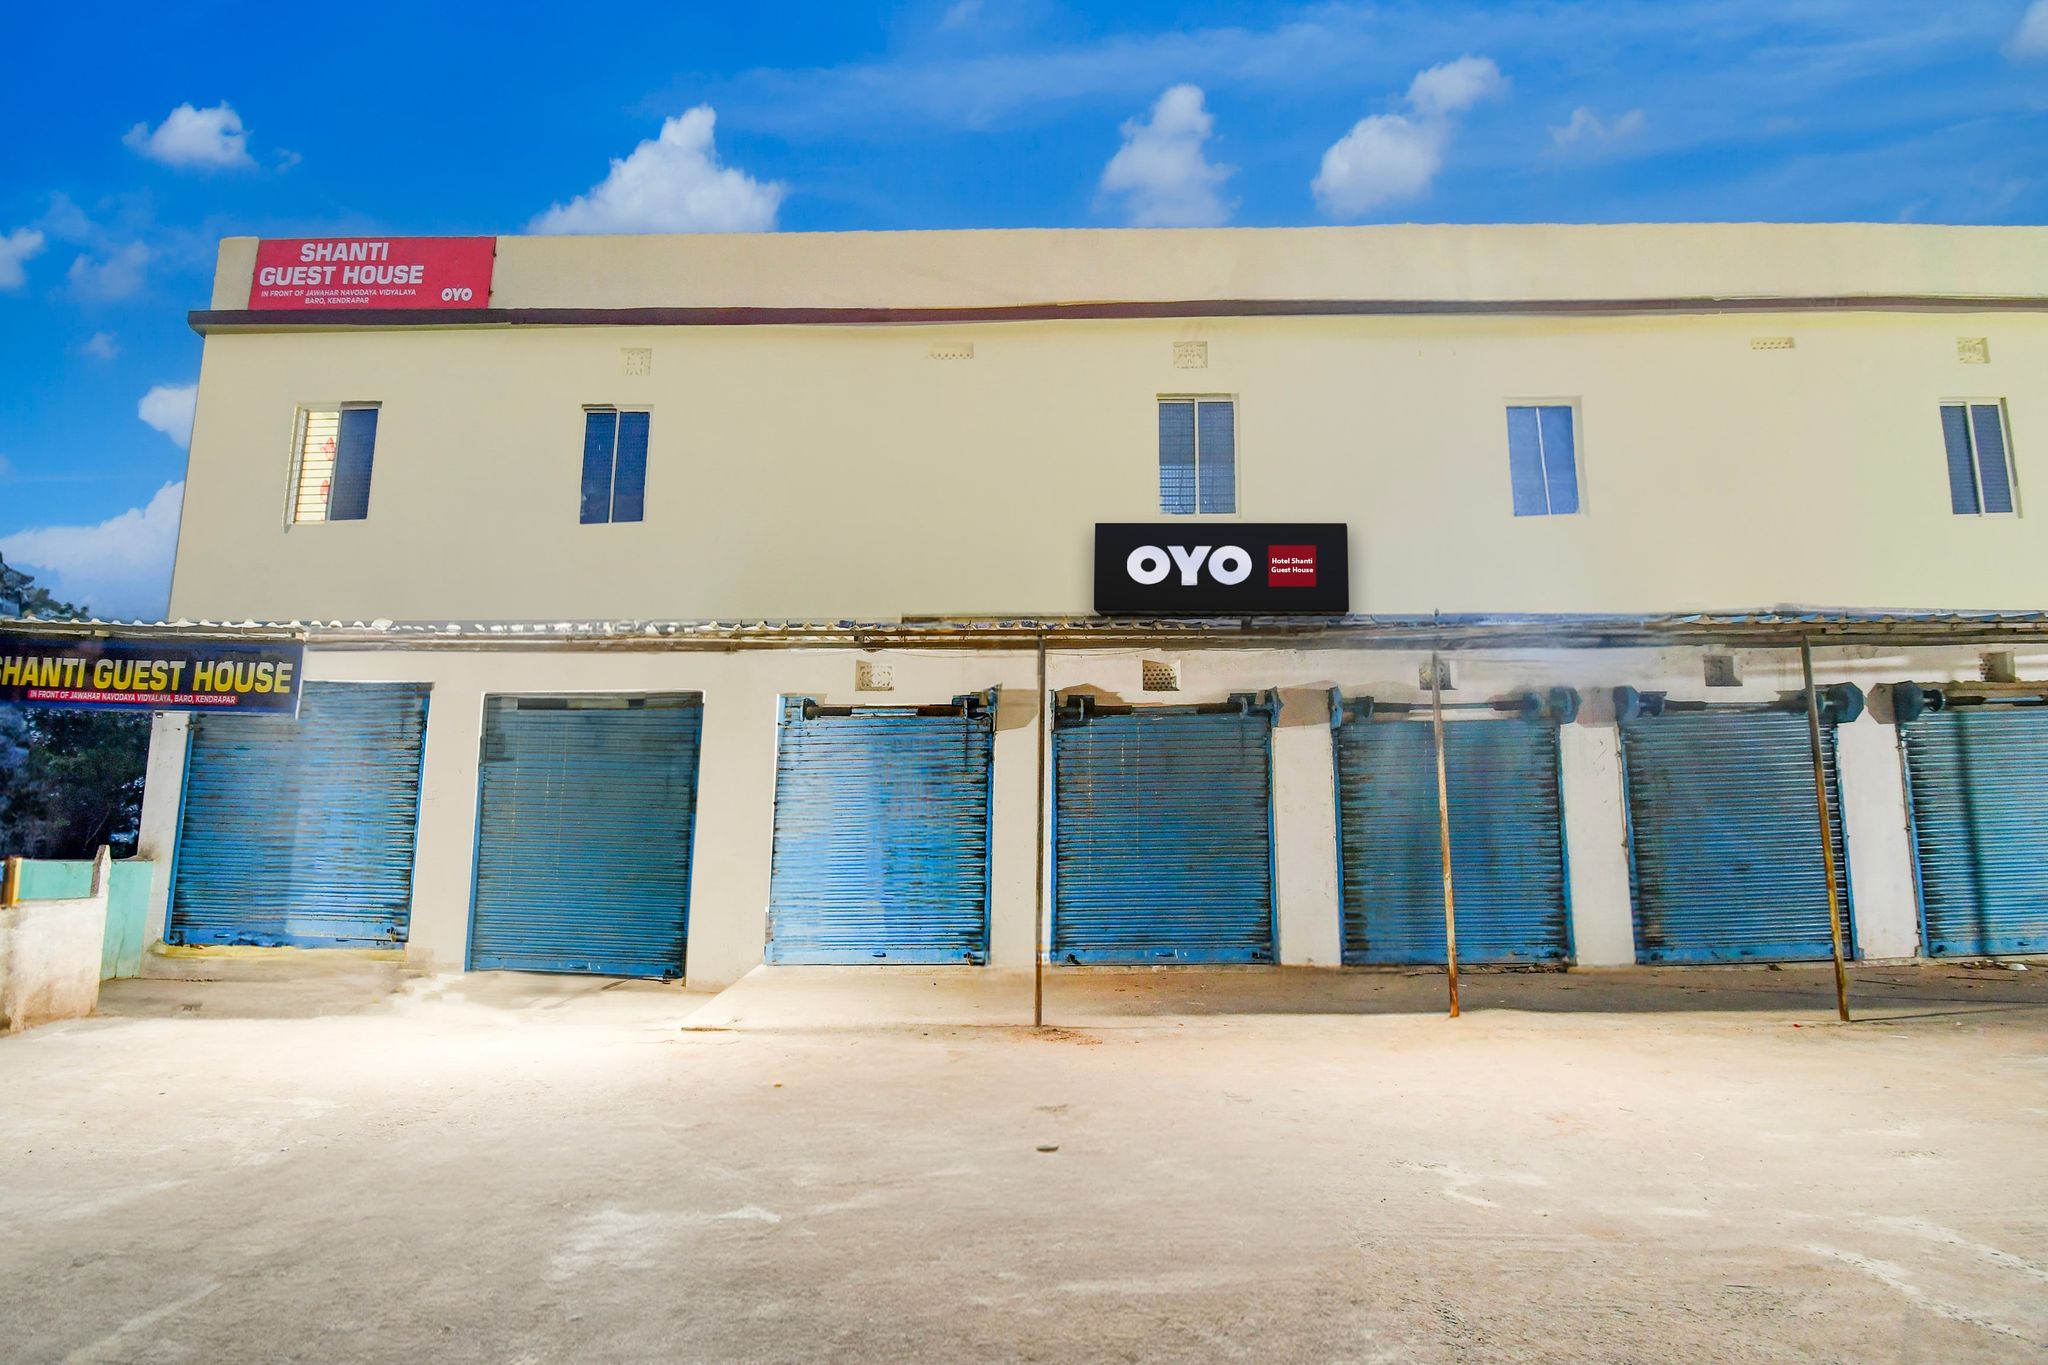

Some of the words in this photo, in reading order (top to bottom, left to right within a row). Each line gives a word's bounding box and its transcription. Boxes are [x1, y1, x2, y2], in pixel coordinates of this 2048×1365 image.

[300, 242, 389, 262] SHANTI
[259, 266, 336, 286] GUEST
[342, 265, 425, 285] HOUSE
[294, 289, 304, 297] OF
[306, 289, 339, 297] JAWAHAR
[340, 289, 377, 297] NAVODAYA
[441, 287, 473, 302] OYO
[1126, 545, 1253, 586] OYO
[0, 656, 87, 688] HANTI
[93, 658, 187, 691] GUEST
[192, 660, 294, 694] HOUSE
[38, 690, 60, 699] FRONT
[60, 691, 70, 699] OF
[70, 691, 101, 700] JAWAHAR
[102, 692, 136, 701] NAVODAYA
[174, 694, 194, 704] BARO,
[196, 695, 236, 704] KENDRAPAR
